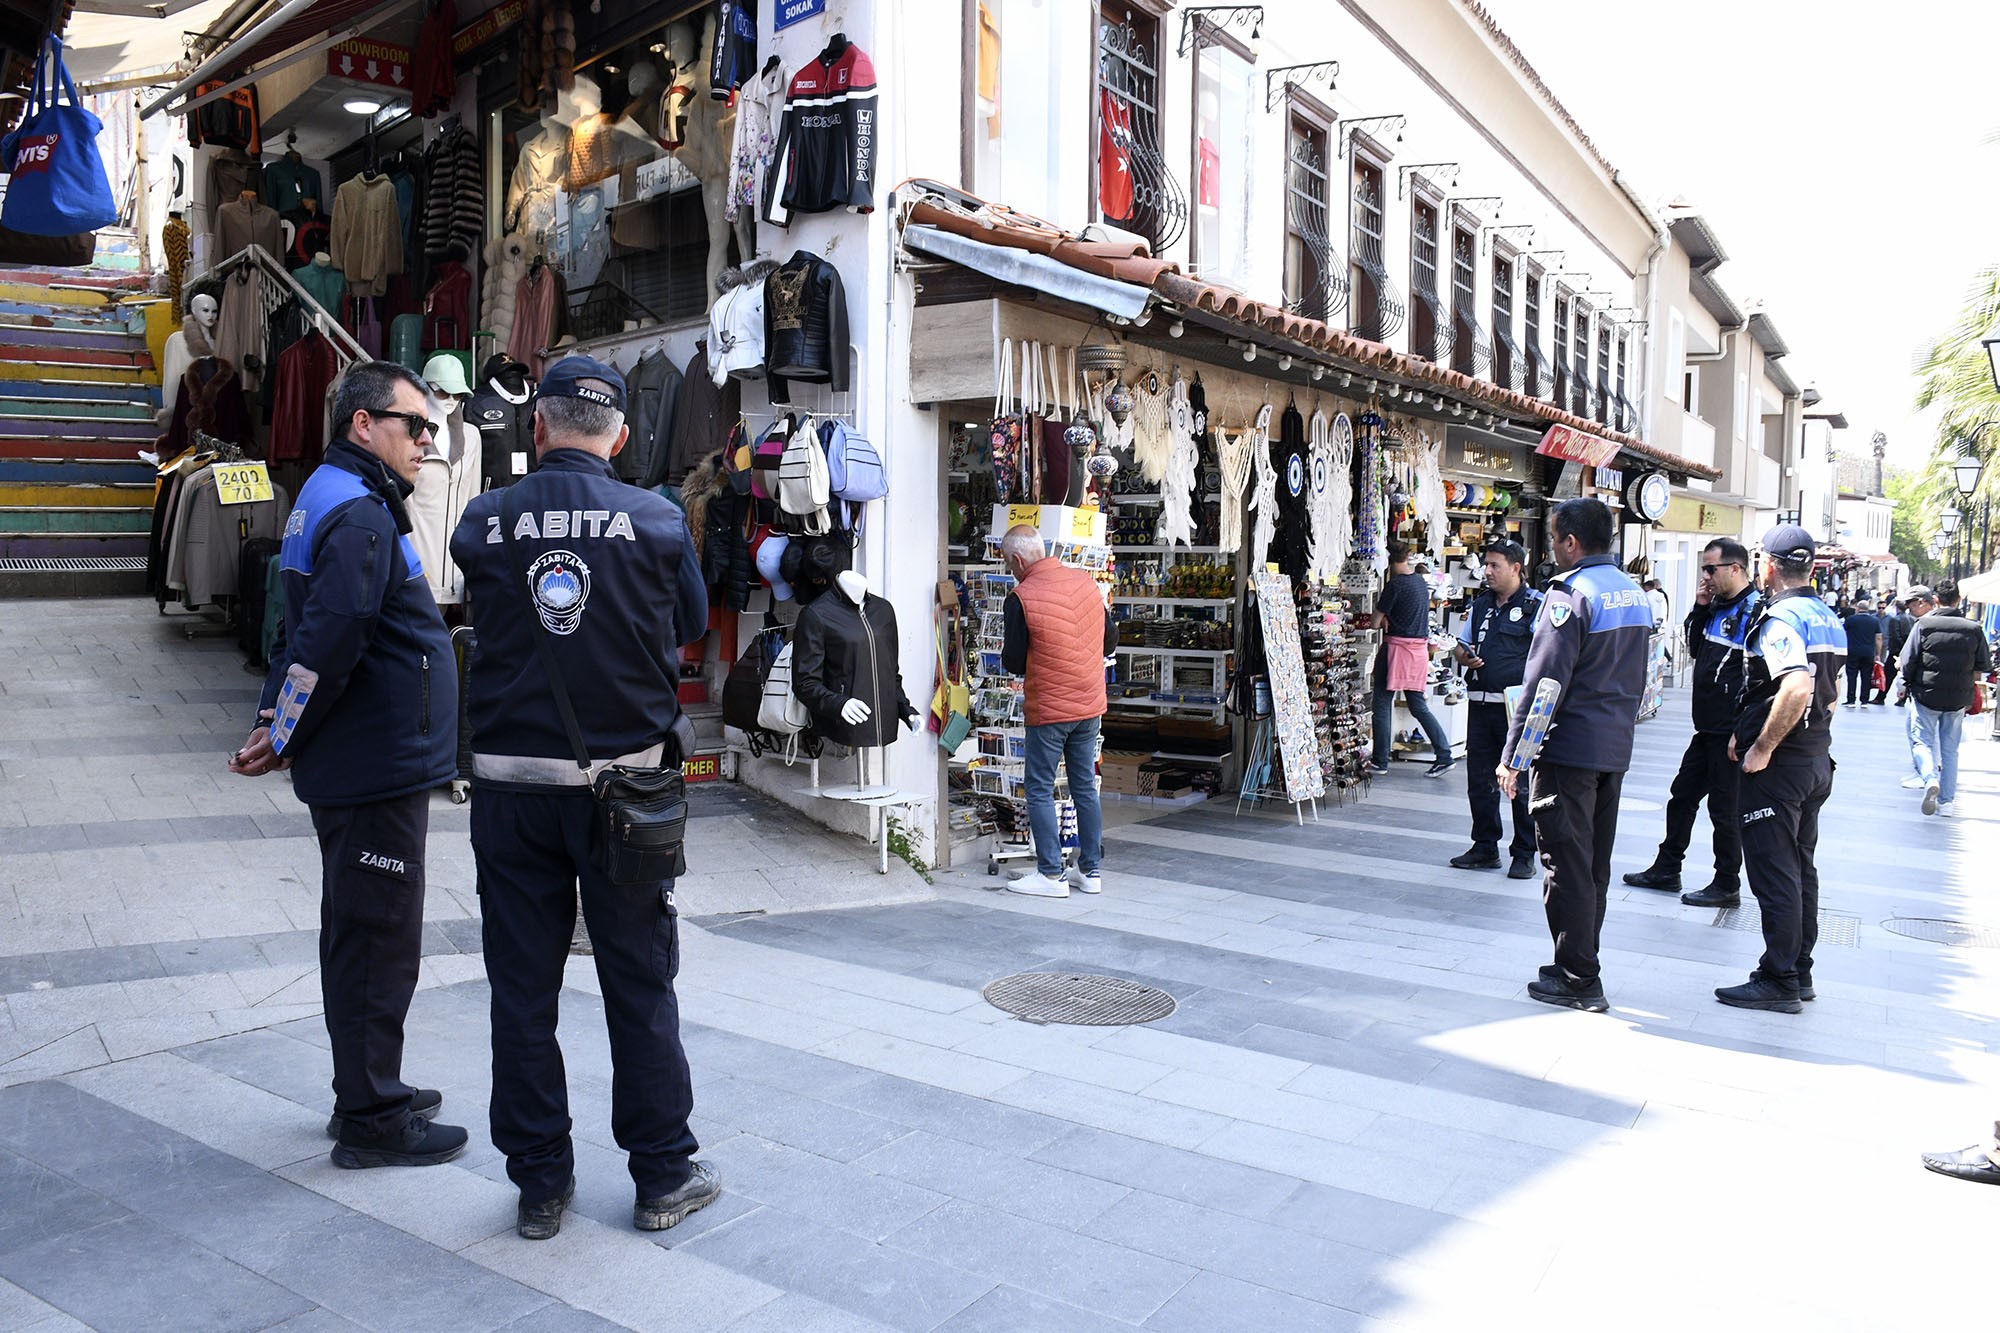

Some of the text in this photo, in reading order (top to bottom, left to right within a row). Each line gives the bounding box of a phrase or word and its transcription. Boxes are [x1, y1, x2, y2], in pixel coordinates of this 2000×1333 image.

[785, 0, 813, 20] SOKAK
[714, 14, 727, 80] YAMAHA
[796, 80, 817, 89] HONDA
[856, 124, 871, 182] HONDA
[578, 388, 610, 406] ZABITA
[220, 470, 260, 486] 2400
[233, 486, 252, 501] 70
[1009, 509, 1018, 521] 5
[486, 510, 636, 544] ZABITA
[540, 554, 579, 568] ZABITA
[1601, 590, 1650, 611] ZABITA
[1471, 607, 1493, 681] ZABIA
[1744, 807, 1776, 824] ZABITA
[360, 851, 405, 874] ZABITA
